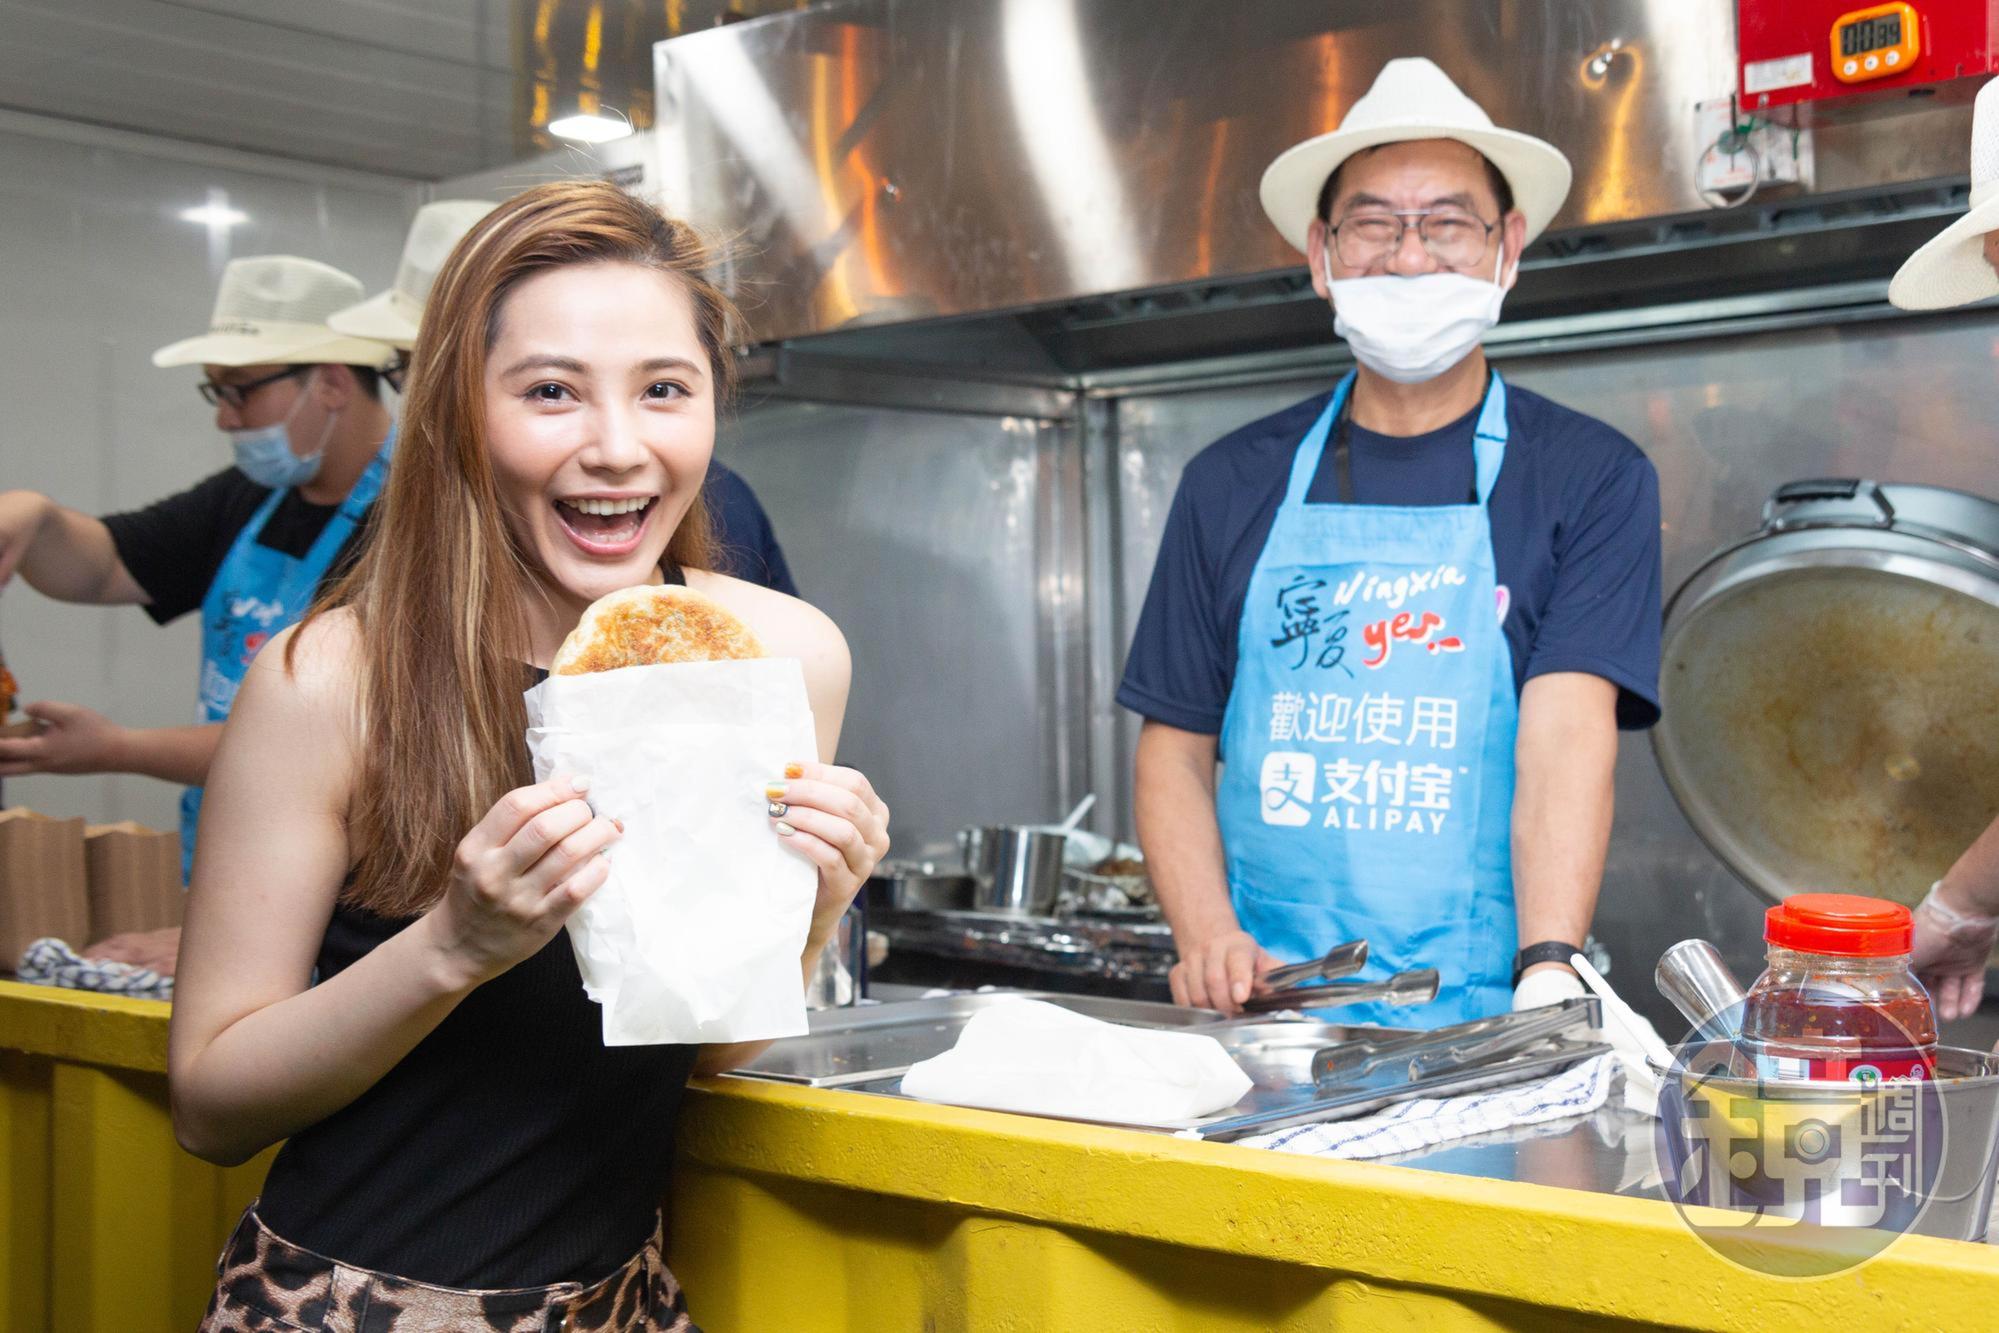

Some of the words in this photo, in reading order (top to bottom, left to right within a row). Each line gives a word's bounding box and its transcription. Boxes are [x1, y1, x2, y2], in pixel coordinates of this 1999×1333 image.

[1269, 691, 1458, 750] 歡迎使用
[1320, 757, 1454, 811] 支付宝
[1323, 806, 1446, 835] ALIPAY
